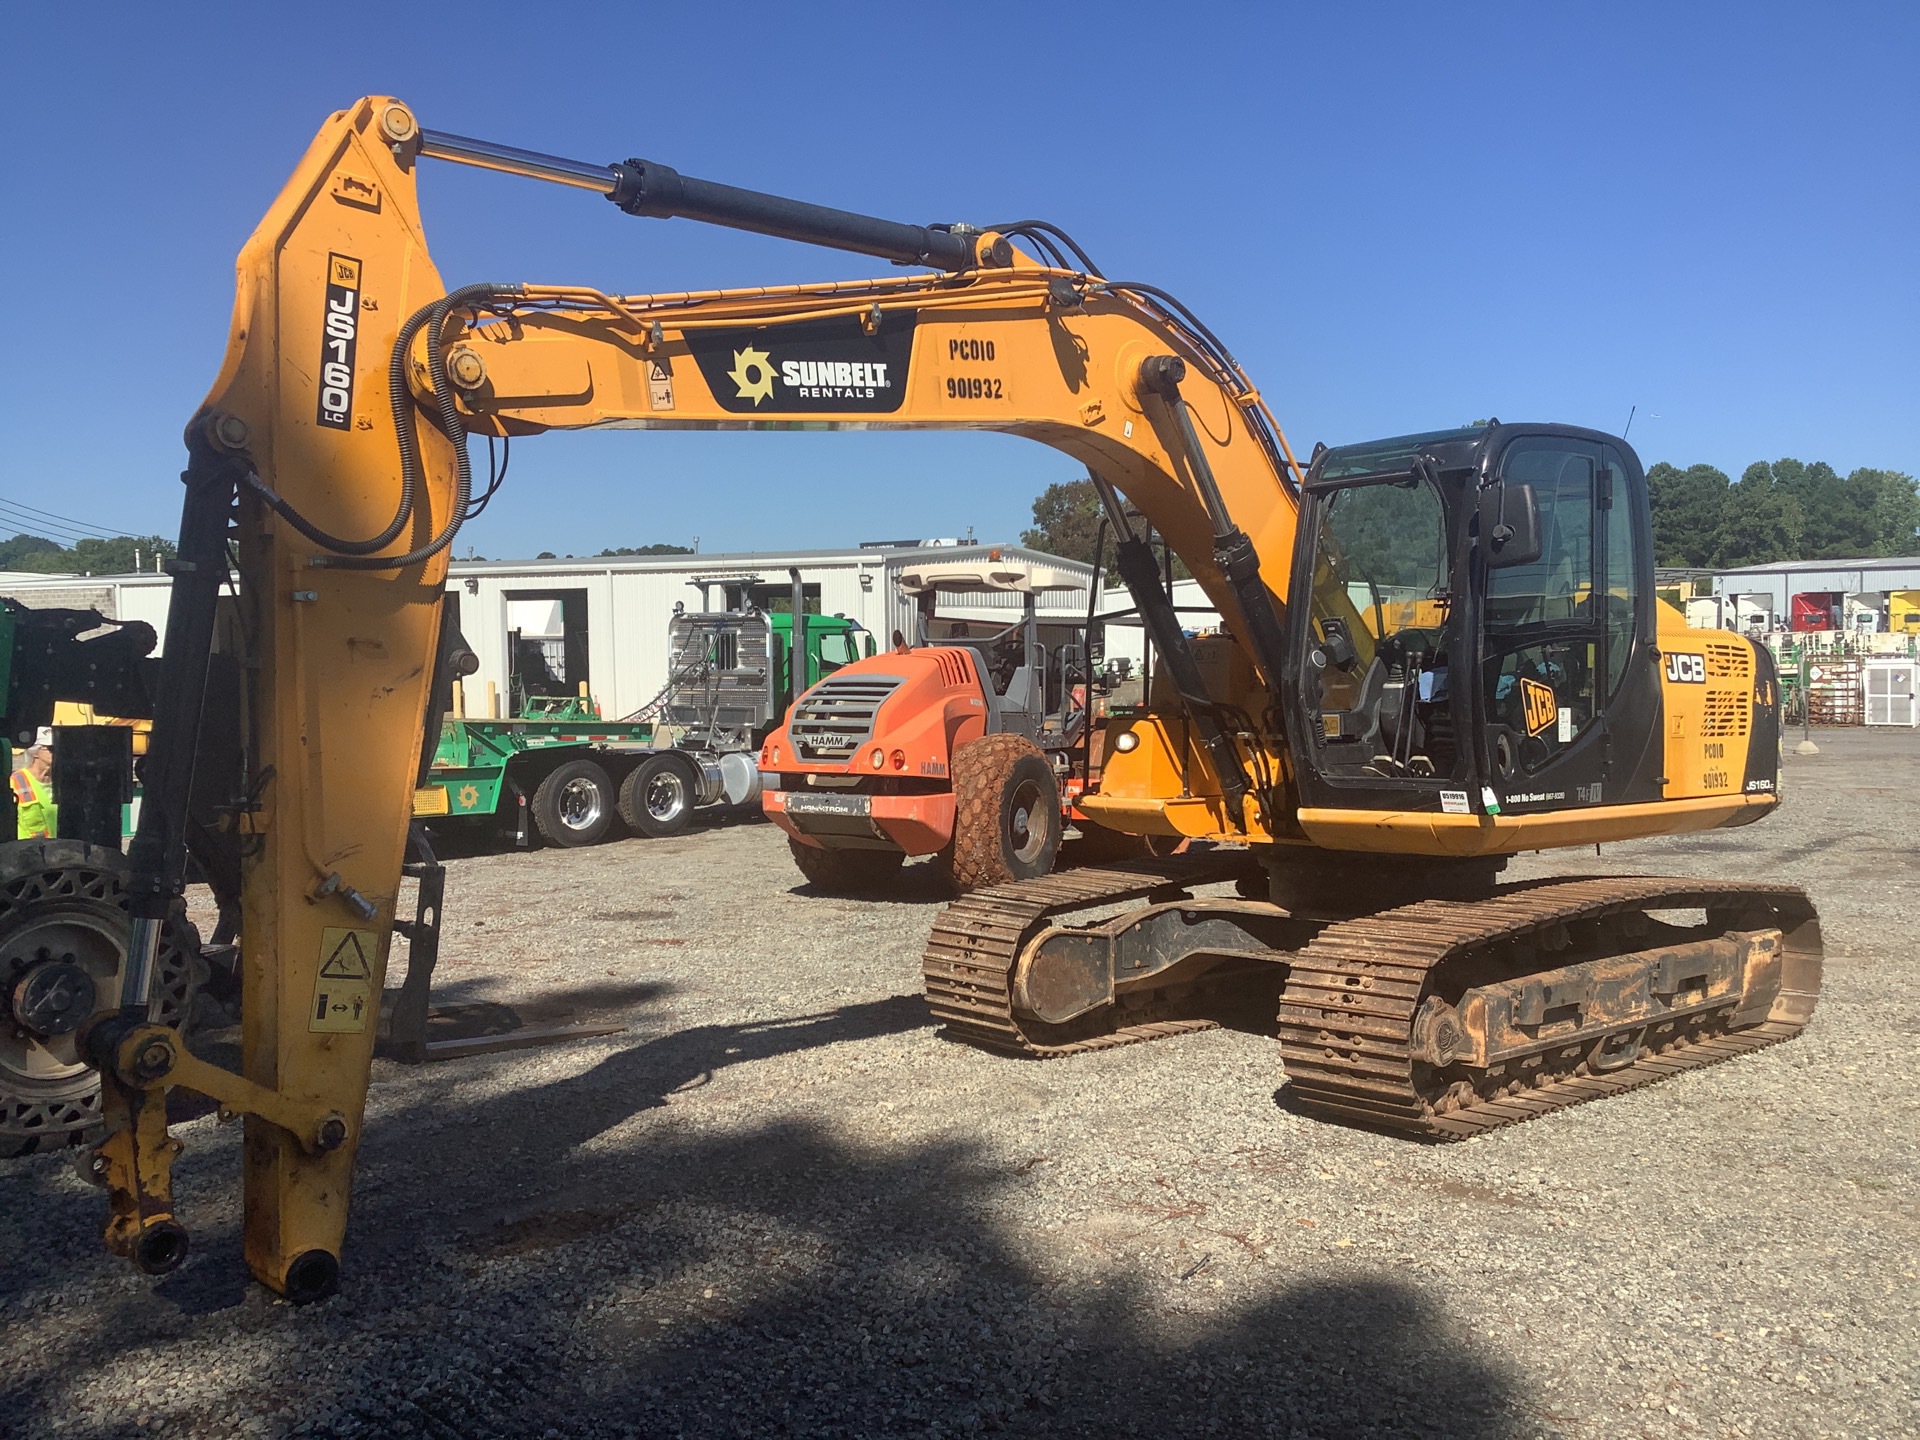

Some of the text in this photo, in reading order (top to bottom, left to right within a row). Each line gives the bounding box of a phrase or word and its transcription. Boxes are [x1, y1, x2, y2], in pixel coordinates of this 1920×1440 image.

[337, 264, 355, 280] JCB
[322, 291, 354, 423] JS160 LC
[782, 360, 887, 387] SUNBELT
[799, 387, 875, 398] RENTALS
[947, 377, 1003, 399] 901932
[1666, 654, 1706, 682] JCB
[1527, 684, 1554, 731] JCB
[811, 736, 844, 746] HAMM
[920, 761, 946, 776] HAMM
[1703, 772, 1729, 789] 901932
[1746, 780, 1771, 791] JS160
[1505, 794, 1521, 804] 1-800
[1521, 793, 1530, 803] No
[1529, 792, 1545, 802] Sweat
